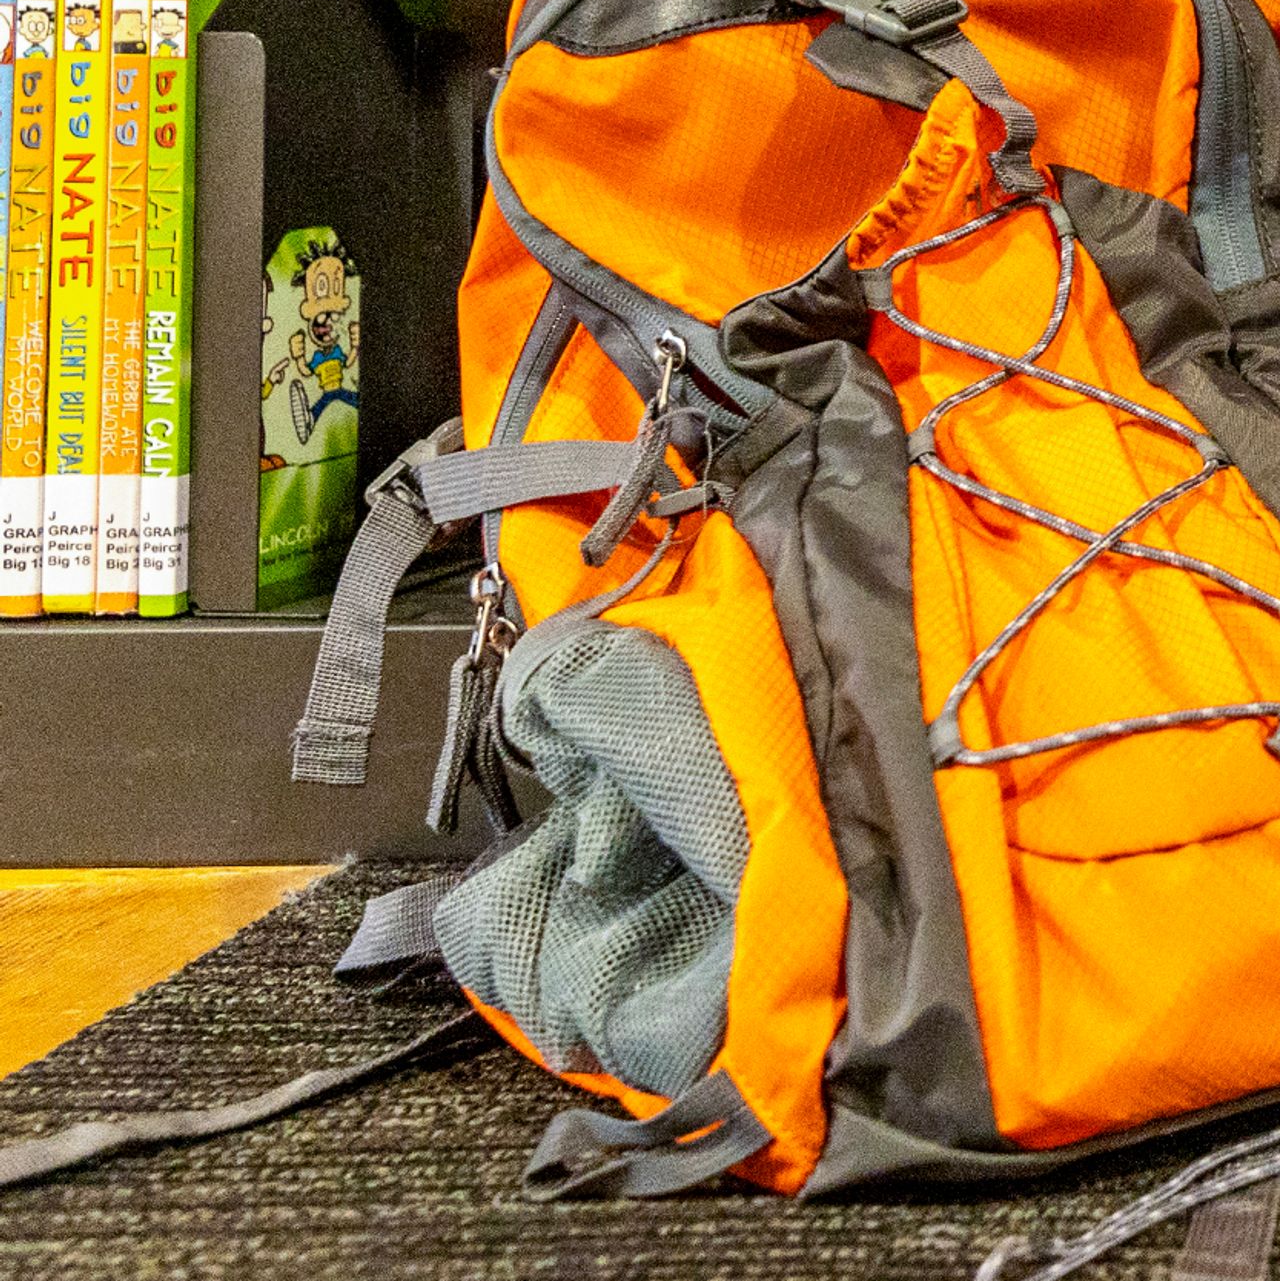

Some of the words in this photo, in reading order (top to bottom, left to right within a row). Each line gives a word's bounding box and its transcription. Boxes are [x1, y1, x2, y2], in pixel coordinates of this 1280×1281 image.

[69, 62, 91, 138] big
[155, 70, 177, 148] big
[60, 153, 96, 287] NATE
[147, 165, 180, 298] NATE
[61, 316, 87, 379] SILENT
[145, 311, 175, 405] REMAIN
[60, 391, 85, 422] BUT
